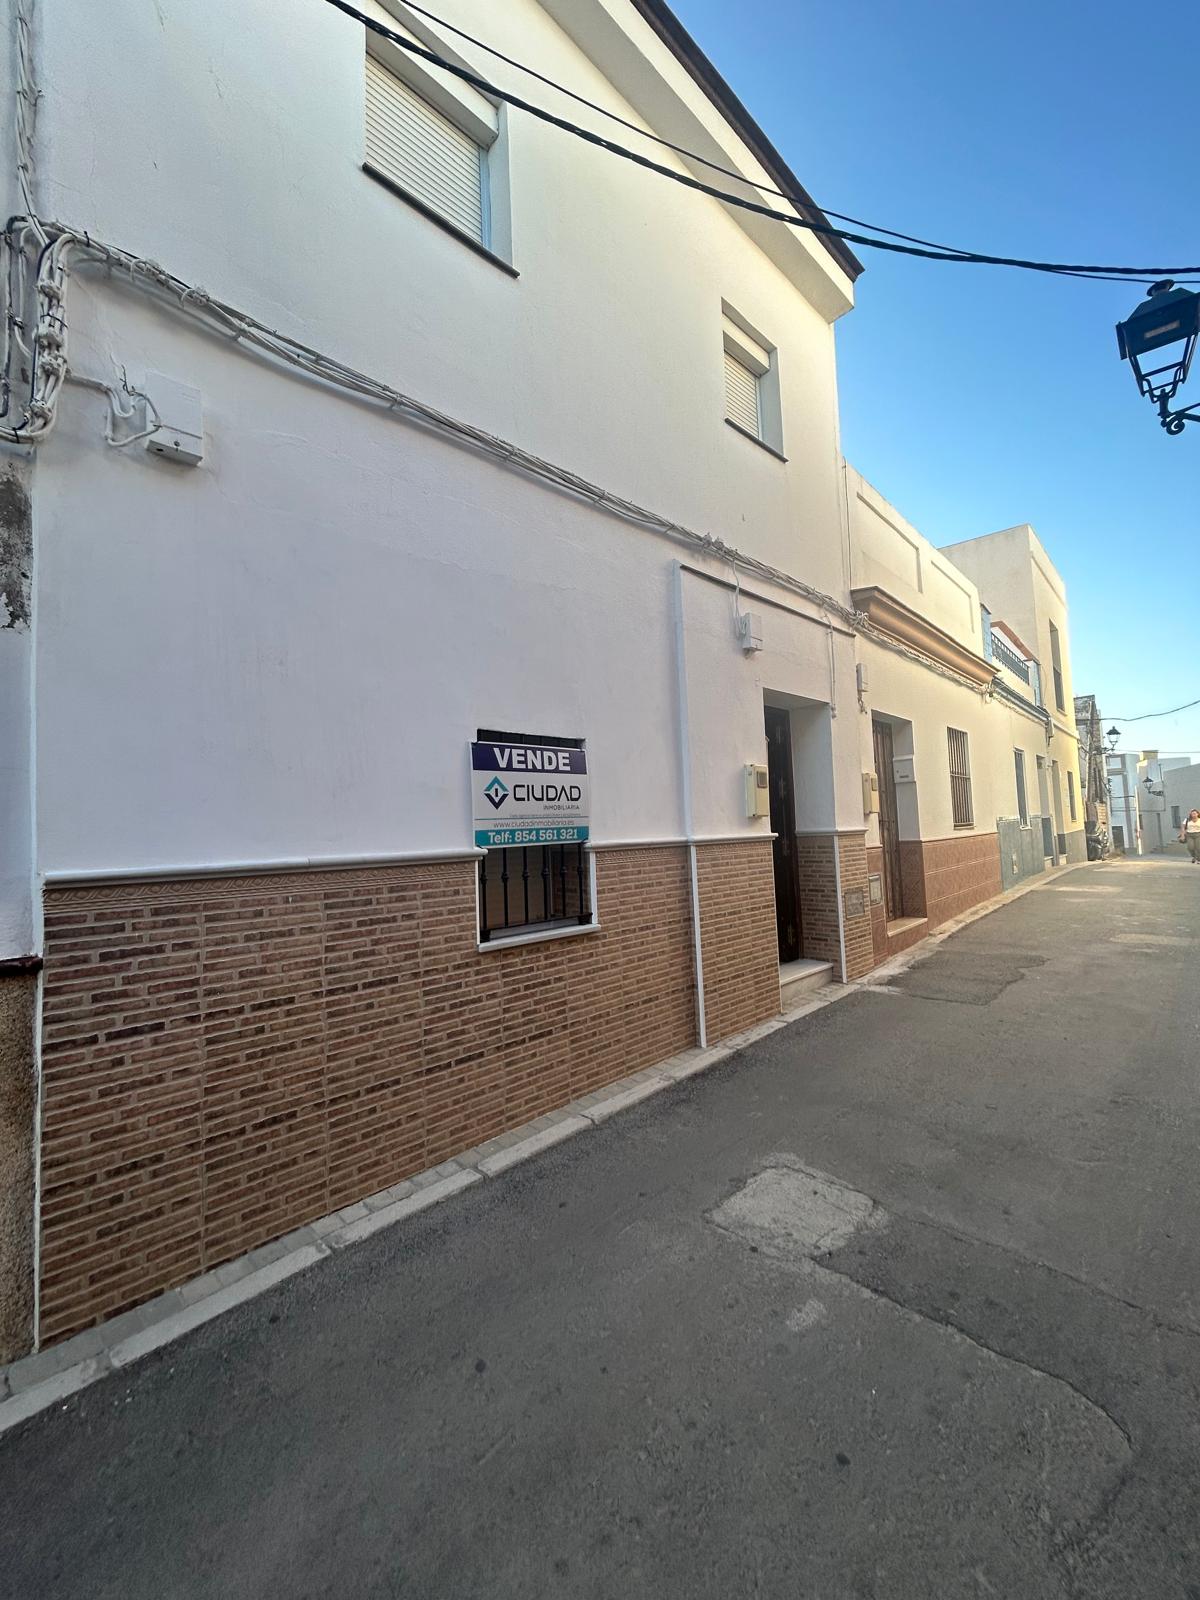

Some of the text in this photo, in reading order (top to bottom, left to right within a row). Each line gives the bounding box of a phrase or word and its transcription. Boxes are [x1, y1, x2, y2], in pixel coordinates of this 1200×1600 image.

[494, 748, 571, 770] VENDE
[513, 784, 581, 802] CIUDAD
[488, 829, 578, 843] Telf: 854 561 321
